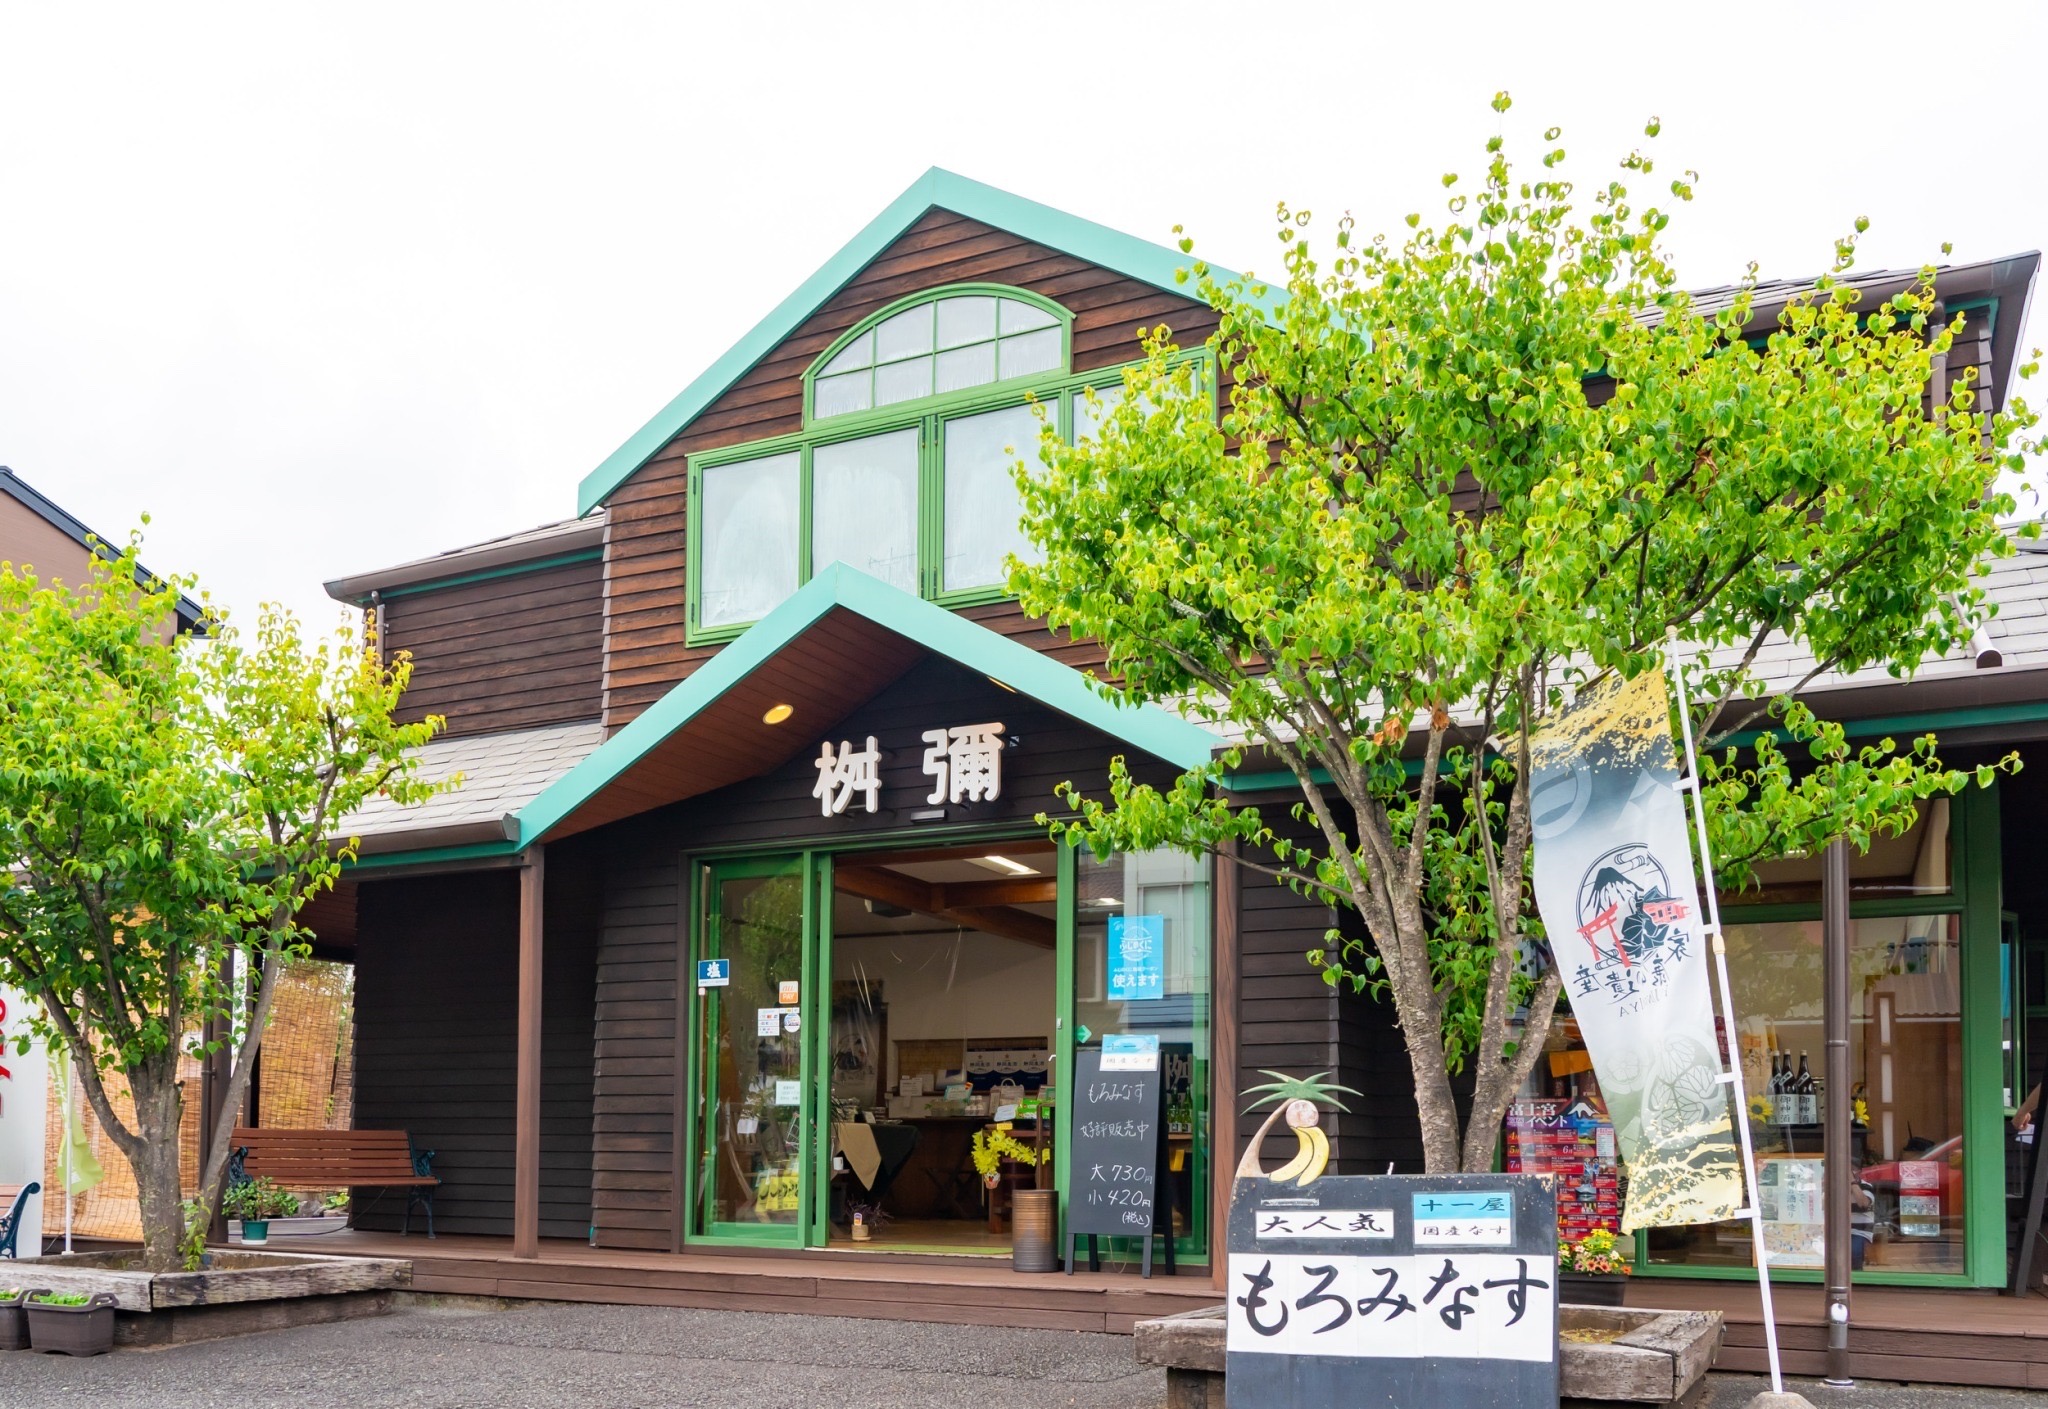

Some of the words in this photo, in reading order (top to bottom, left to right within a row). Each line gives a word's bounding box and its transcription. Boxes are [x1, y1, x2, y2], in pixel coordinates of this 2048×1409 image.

[707, 961, 721, 978] 塩
[1113, 974, 1159, 987] 使えます
[1088, 1080, 1146, 1104] もろみなす
[1509, 1103, 1557, 1116] 富士宮
[1526, 1115, 1568, 1128] イベント
[1080, 1120, 1149, 1142] 好評販売中
[1562, 1145, 1573, 1155] 6月
[1510, 1161, 1520, 1169] 7月
[1421, 1198, 1505, 1213] 十一屋
[1259, 1212, 1385, 1234] 大人気
[1422, 1225, 1507, 1237] 国産なす
[1236, 1257, 1550, 1337] もろみなす
